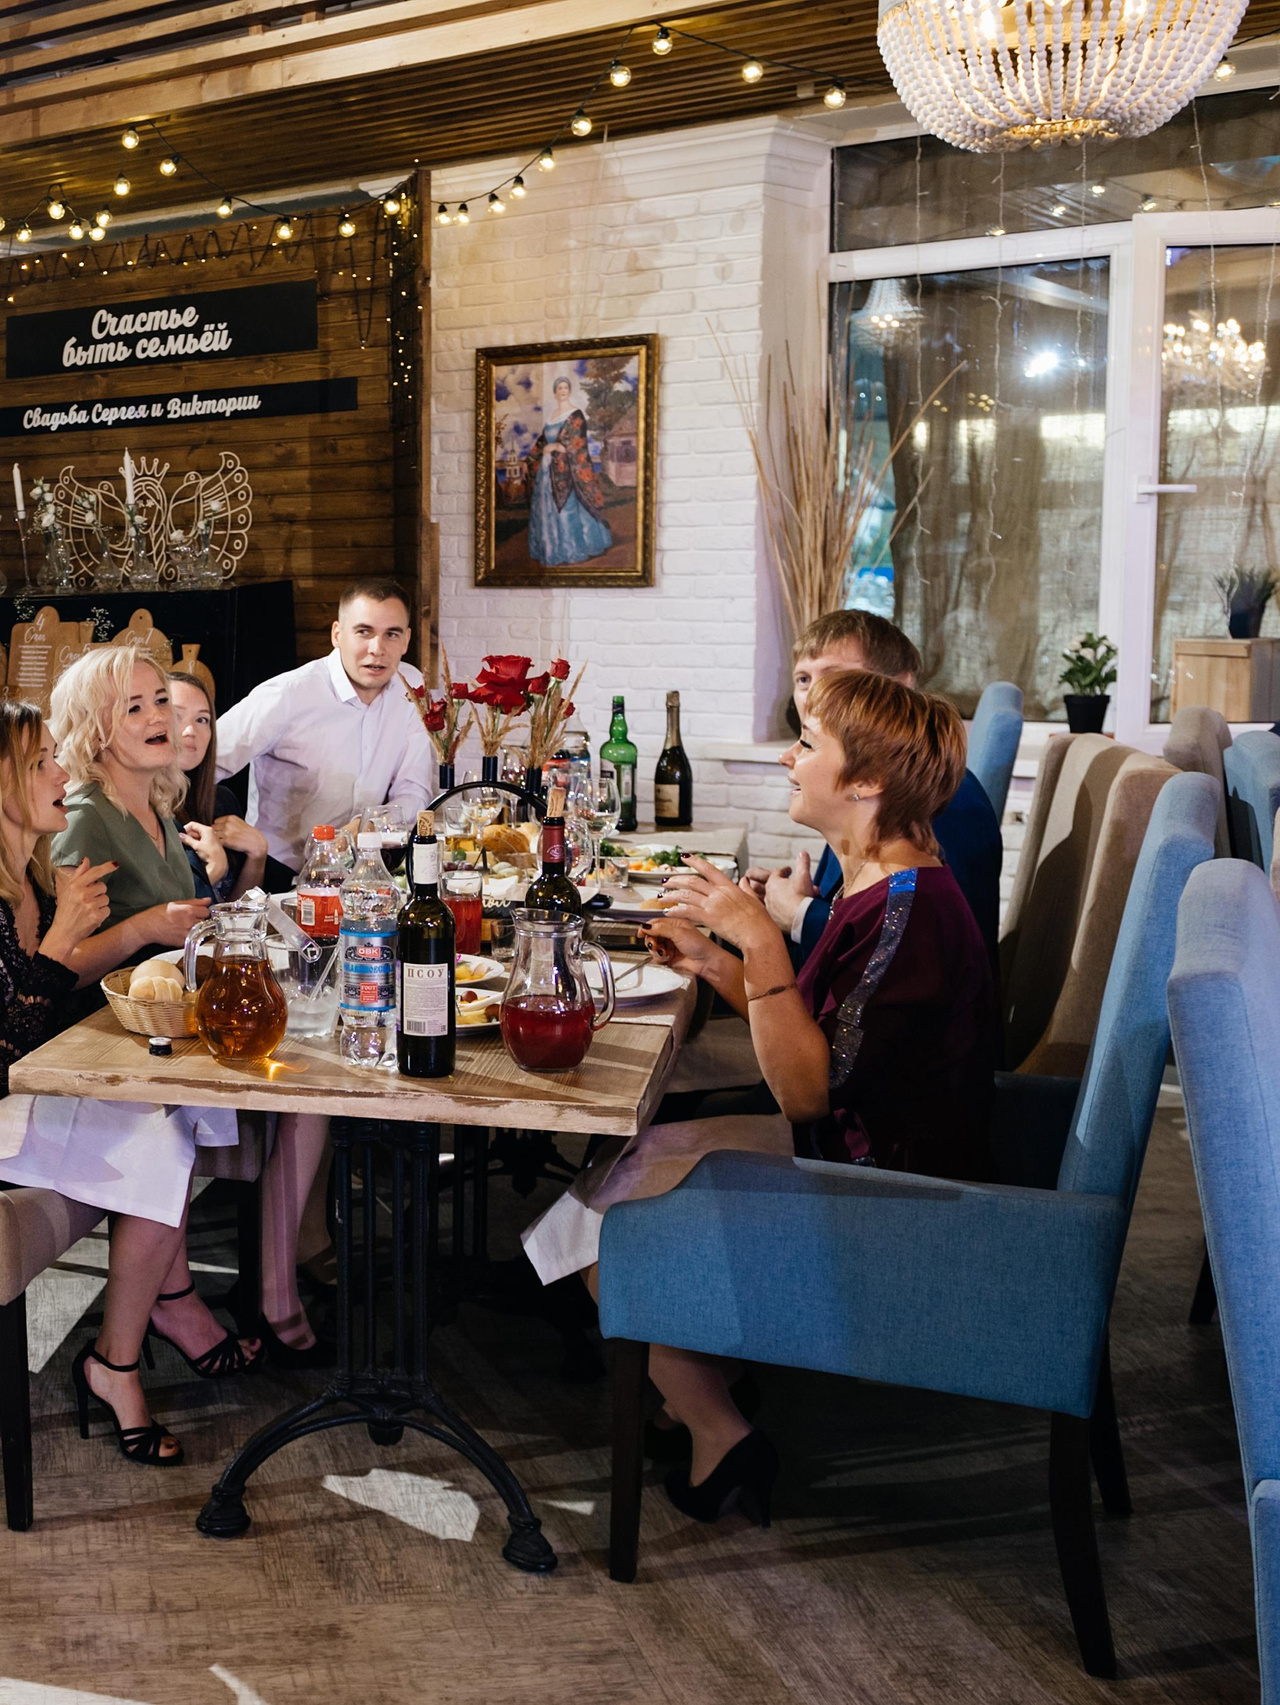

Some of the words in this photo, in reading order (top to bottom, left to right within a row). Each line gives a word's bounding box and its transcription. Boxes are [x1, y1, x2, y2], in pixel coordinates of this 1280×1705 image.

[91, 306, 198, 339] Счастье
[61, 336, 133, 368] быть
[135, 324, 233, 359] семьёй
[23, 404, 89, 431] Свадьба
[90, 402, 150, 425] Сергея
[150, 402, 164, 418] и
[167, 394, 261, 419] Виктории
[36, 614, 45, 631] 4
[407, 968, 445, 979] ПСОУ
